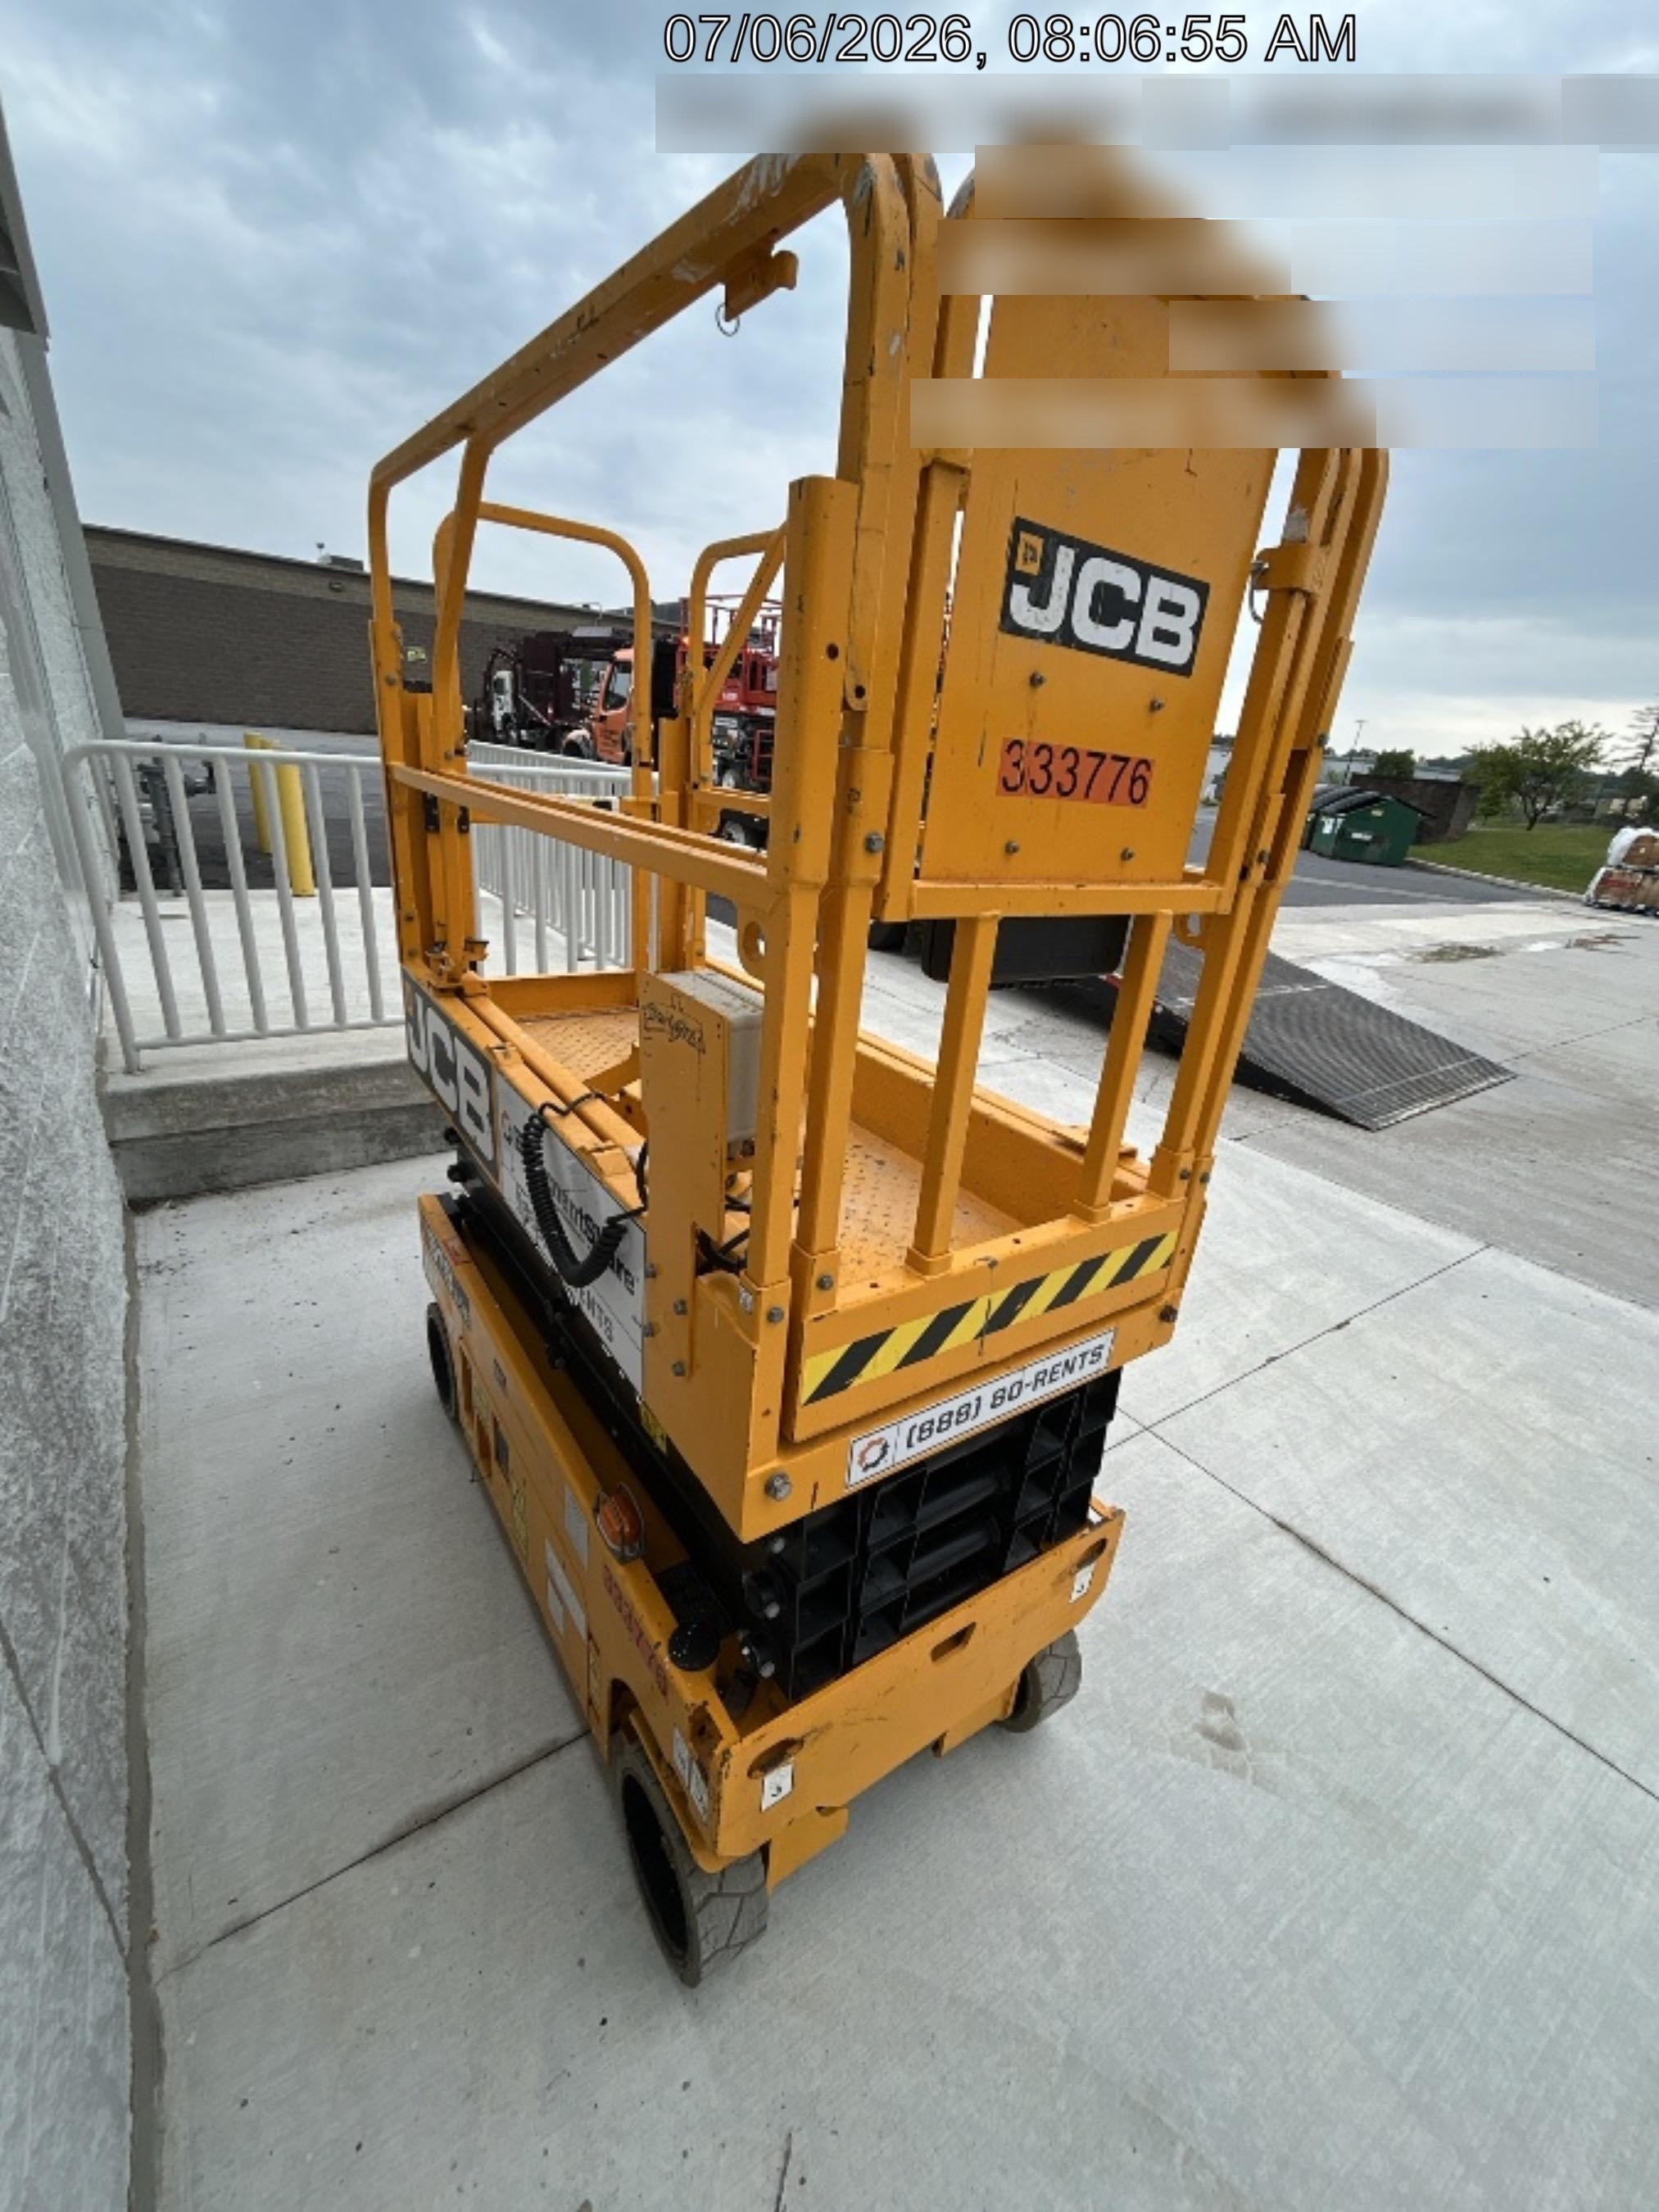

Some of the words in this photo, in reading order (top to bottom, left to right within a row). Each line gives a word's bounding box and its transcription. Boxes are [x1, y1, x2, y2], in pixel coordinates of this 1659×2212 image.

[1009, 545, 1201, 666] JCB
[1002, 739, 1151, 805] 333776
[408, 992, 493, 1161] JCB
[906, 1397, 982, 1448] (888)
[990, 1343, 1105, 1410] 80-RENTS
